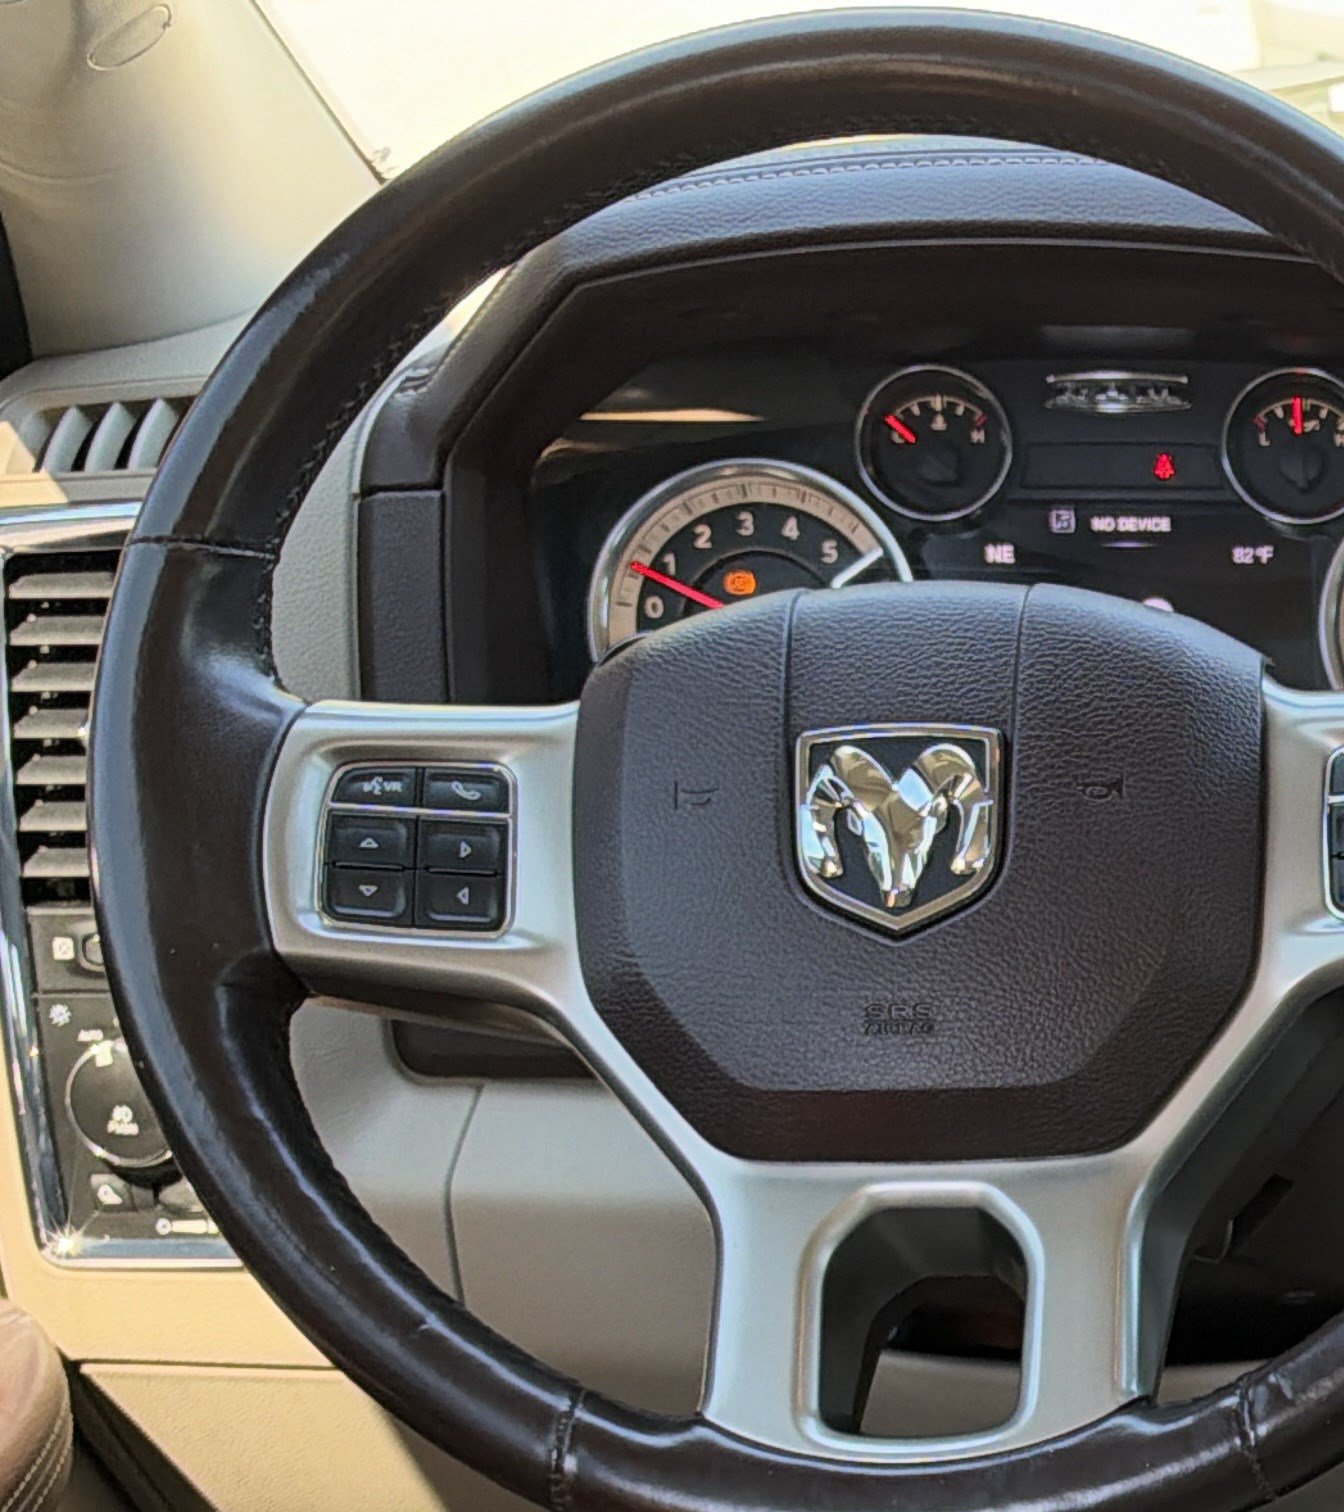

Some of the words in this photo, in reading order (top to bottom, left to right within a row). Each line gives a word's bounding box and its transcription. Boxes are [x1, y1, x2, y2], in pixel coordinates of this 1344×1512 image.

[736, 511, 754, 536] 3
[781, 516, 800, 540] 4
[1090, 516, 1115, 532] NO
[1116, 516, 1172, 532] DEVICE
[693, 524, 713, 549] 2
[820, 538, 838, 564] 5
[984, 543, 1015, 564] NE
[662, 553, 676, 575] 1
[644, 596, 664, 619] 0
